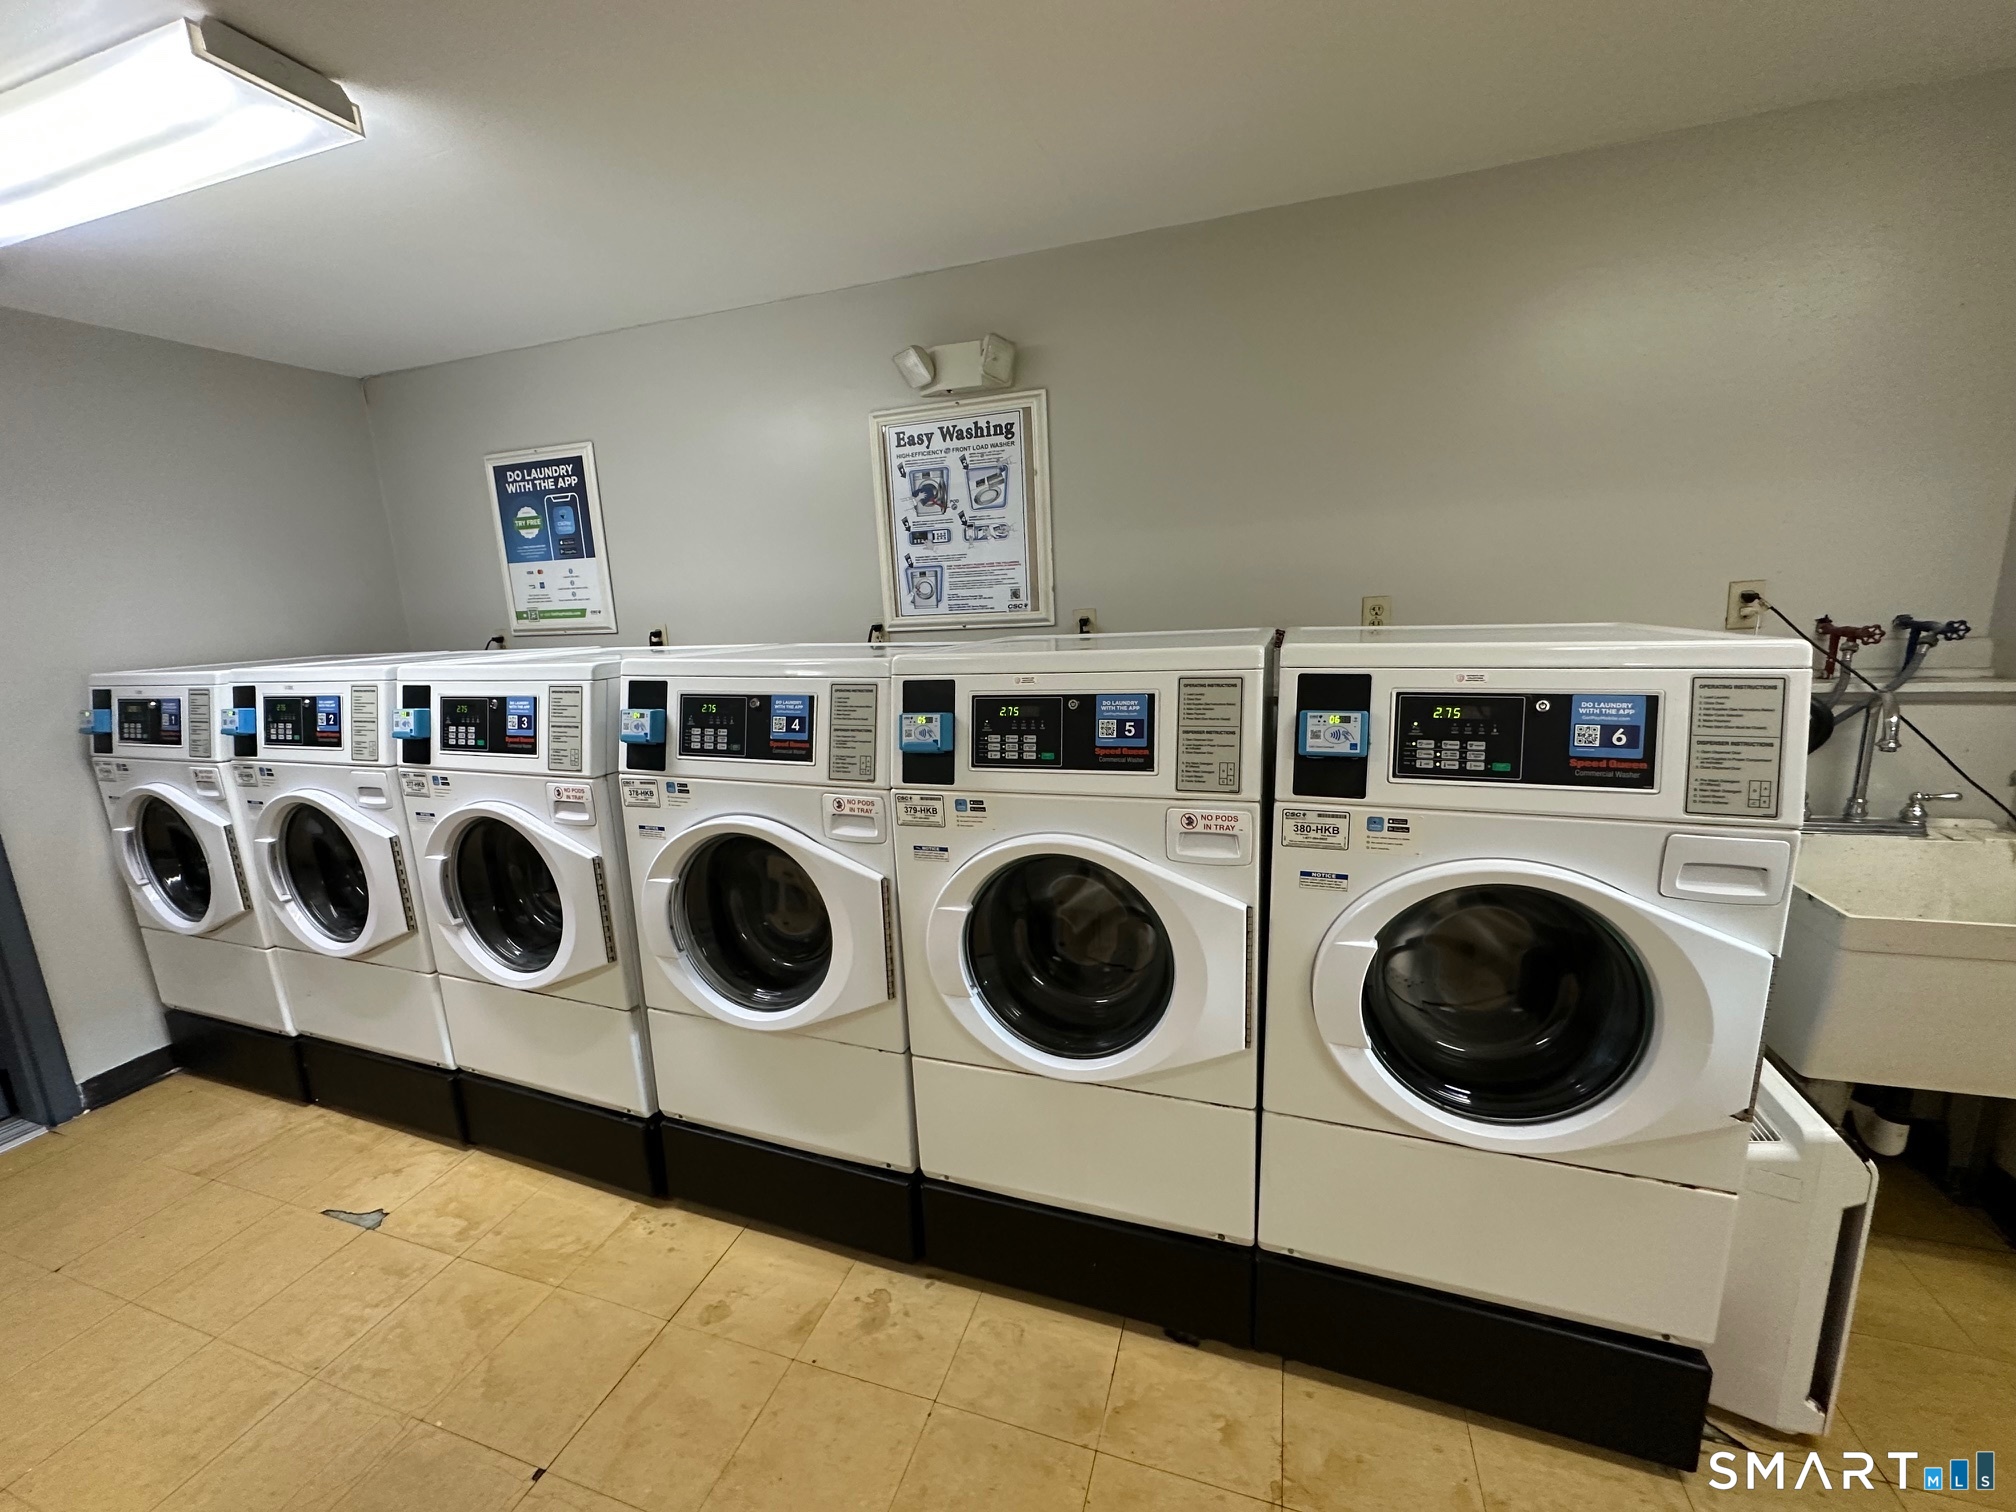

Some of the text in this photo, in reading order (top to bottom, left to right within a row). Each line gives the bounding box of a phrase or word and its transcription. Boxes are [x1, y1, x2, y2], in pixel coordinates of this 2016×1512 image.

[895, 420, 1015, 449] Easy Washing
[896, 449, 943, 459] HIGH-EFFICIENCY
[972, 443, 989, 451] LOAD
[990, 440, 1015, 449] WASHER
[506, 464, 573, 482] DO LAUNDRY
[506, 476, 578, 494] WITH THE APP
[999, 706, 1019, 717] 2.75
[1433, 707, 1461, 719] 2.75
[171, 715, 175, 725] 1
[328, 714, 334, 724] 2
[521, 717, 528, 728] 3
[791, 718, 800, 731] 4
[1329, 715, 1340, 724] 06
[1124, 722, 1136, 737] 5
[1612, 728, 1627, 746] 6
[1094, 747, 1150, 756] Speed Queen
[1569, 758, 1648, 769] Speed Queen
[1574, 769, 1614, 777] Commercial
[628, 789, 654, 797] 378-HKB
[857, 799, 875, 807] PODS
[904, 806, 938, 815] 379-HKB
[1200, 814, 1239, 823] NO PODS
[1203, 823, 1236, 832] IN TRAY
[1293, 824, 1340, 835] 380-HKB
